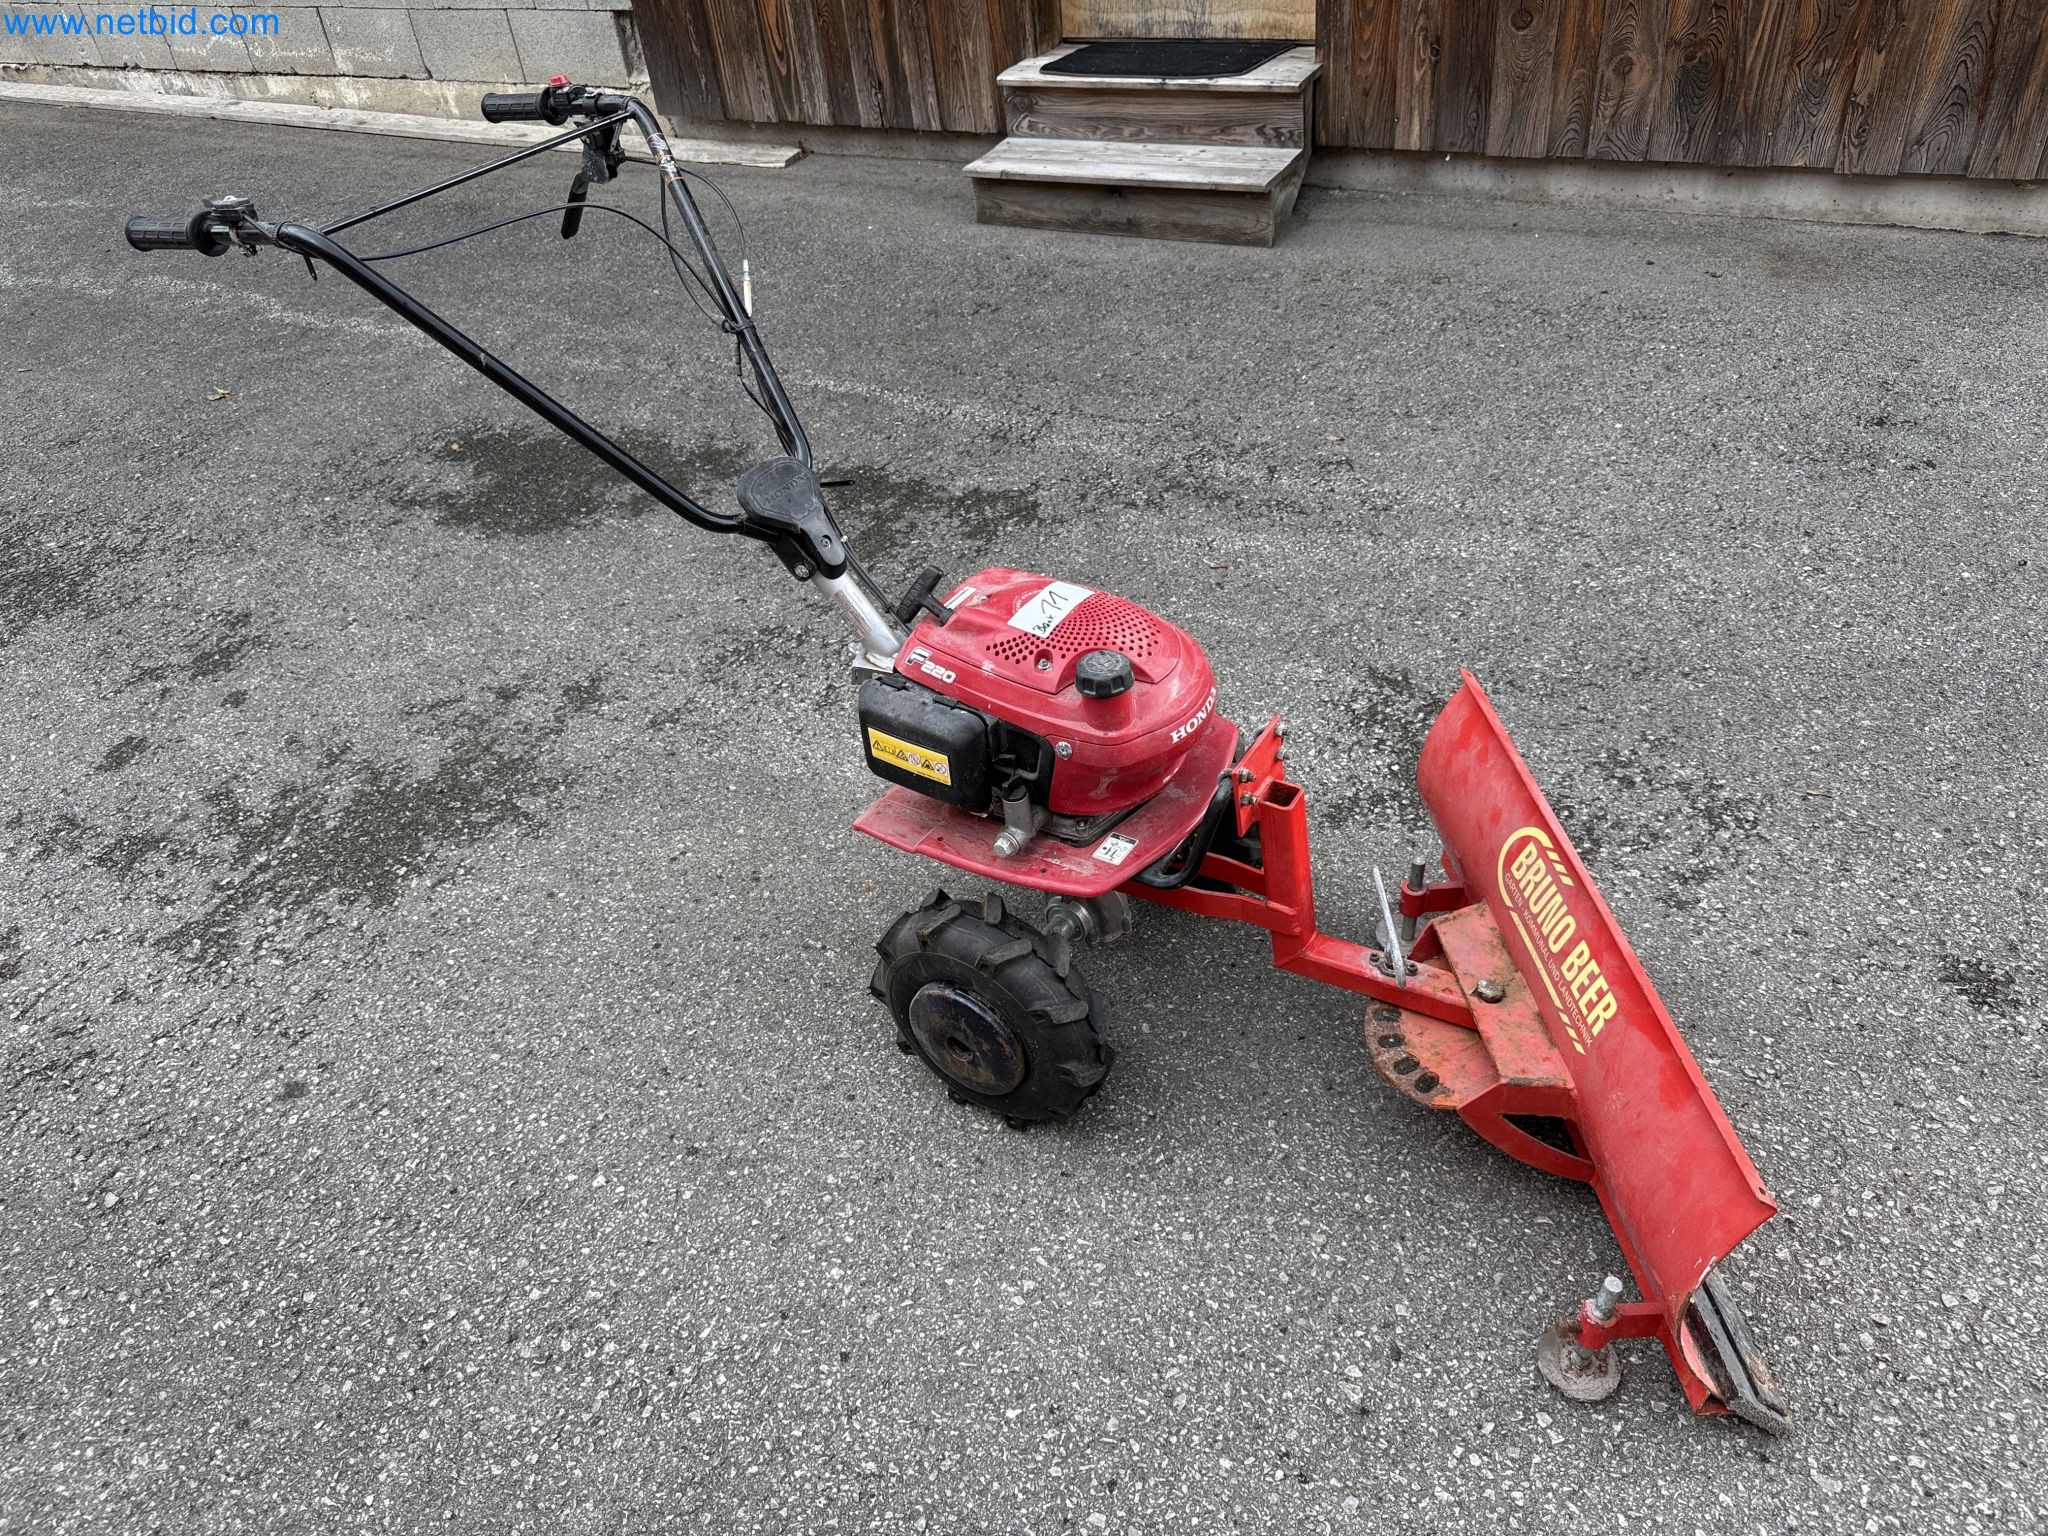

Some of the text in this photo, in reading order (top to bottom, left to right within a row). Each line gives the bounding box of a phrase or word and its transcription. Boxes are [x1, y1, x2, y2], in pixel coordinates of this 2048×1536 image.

[905, 646, 957, 684] F220
[1504, 873, 1524, 908] GARTEN
[1523, 911, 1550, 961] KOMMUNAL
[1548, 959, 1560, 980] UND
[1557, 980, 1593, 1047] LANDTECHNIK
[1510, 841, 1618, 1037] BRUNO BEER
